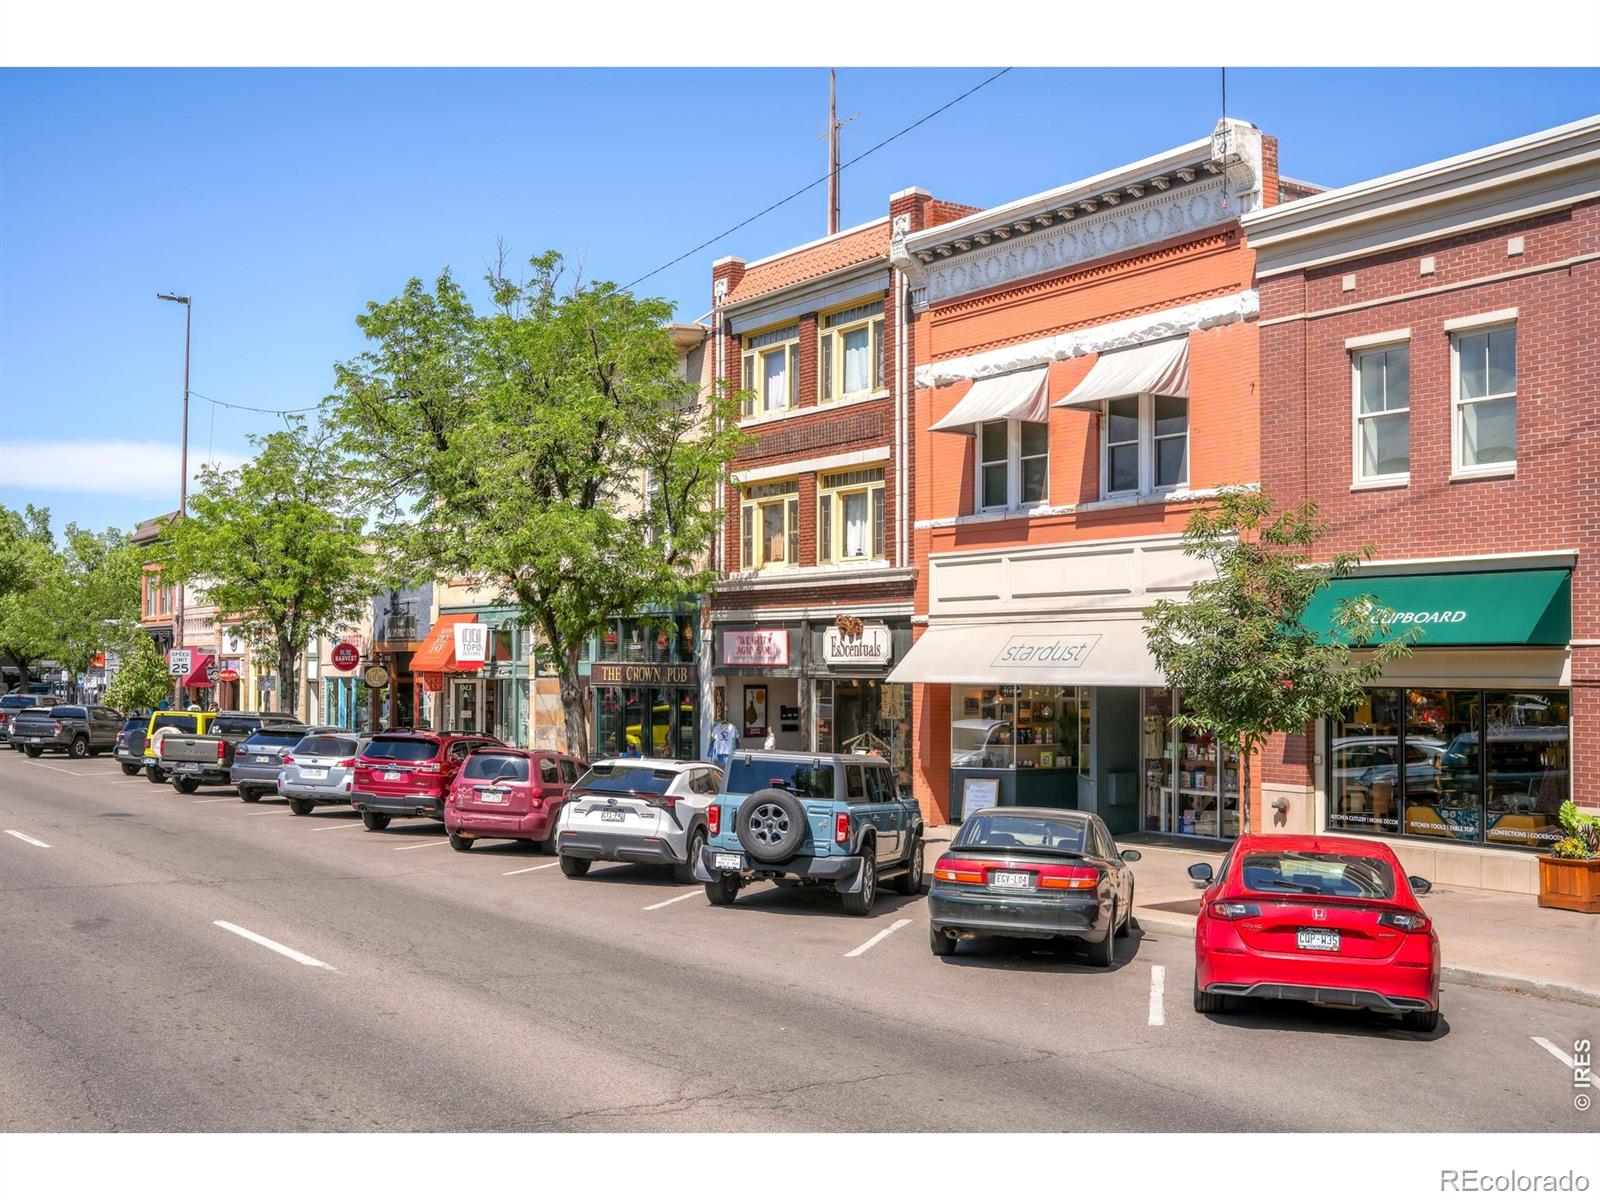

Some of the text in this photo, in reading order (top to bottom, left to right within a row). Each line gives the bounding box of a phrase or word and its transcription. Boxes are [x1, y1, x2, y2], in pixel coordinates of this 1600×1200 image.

[463, 643, 482, 651] TOPO
[1001, 640, 1088, 661] stardust
[172, 663, 189, 673] 25
[602, 666, 688, 682] THE CROWN PUB
[1491, 829, 1527, 837] CONFECTIONS
